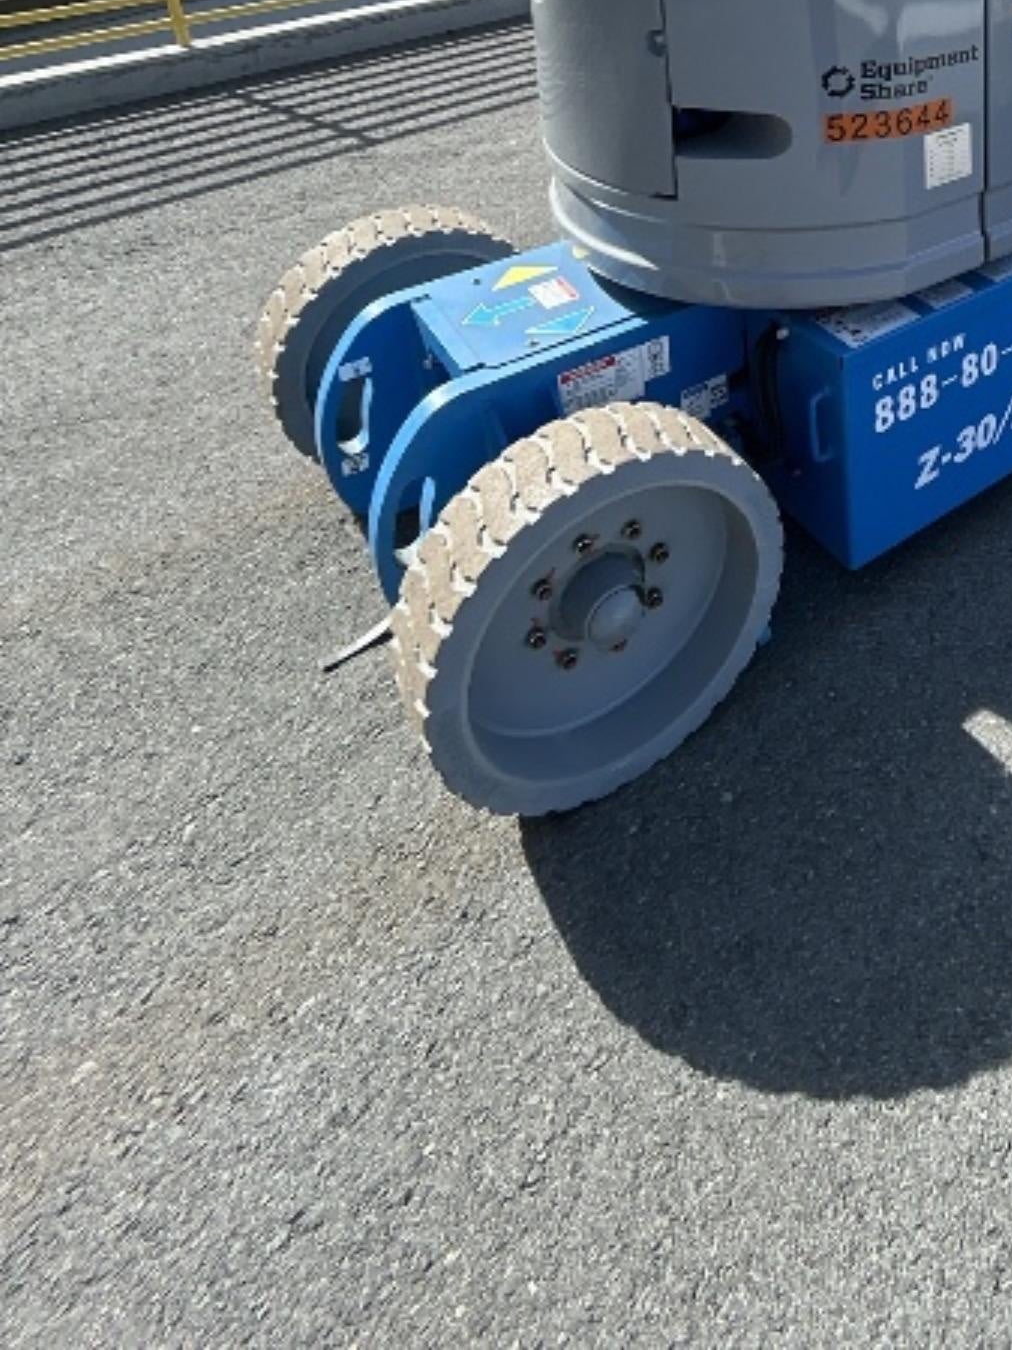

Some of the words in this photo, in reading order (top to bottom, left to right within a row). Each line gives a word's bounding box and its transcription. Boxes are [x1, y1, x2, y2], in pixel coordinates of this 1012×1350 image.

[860, 44, 978, 81] Equipment
[860, 81, 928, 100] Share
[827, 99, 949, 141] 523644
[872, 356, 919, 391] CALL
[926, 333, 967, 363] NOW
